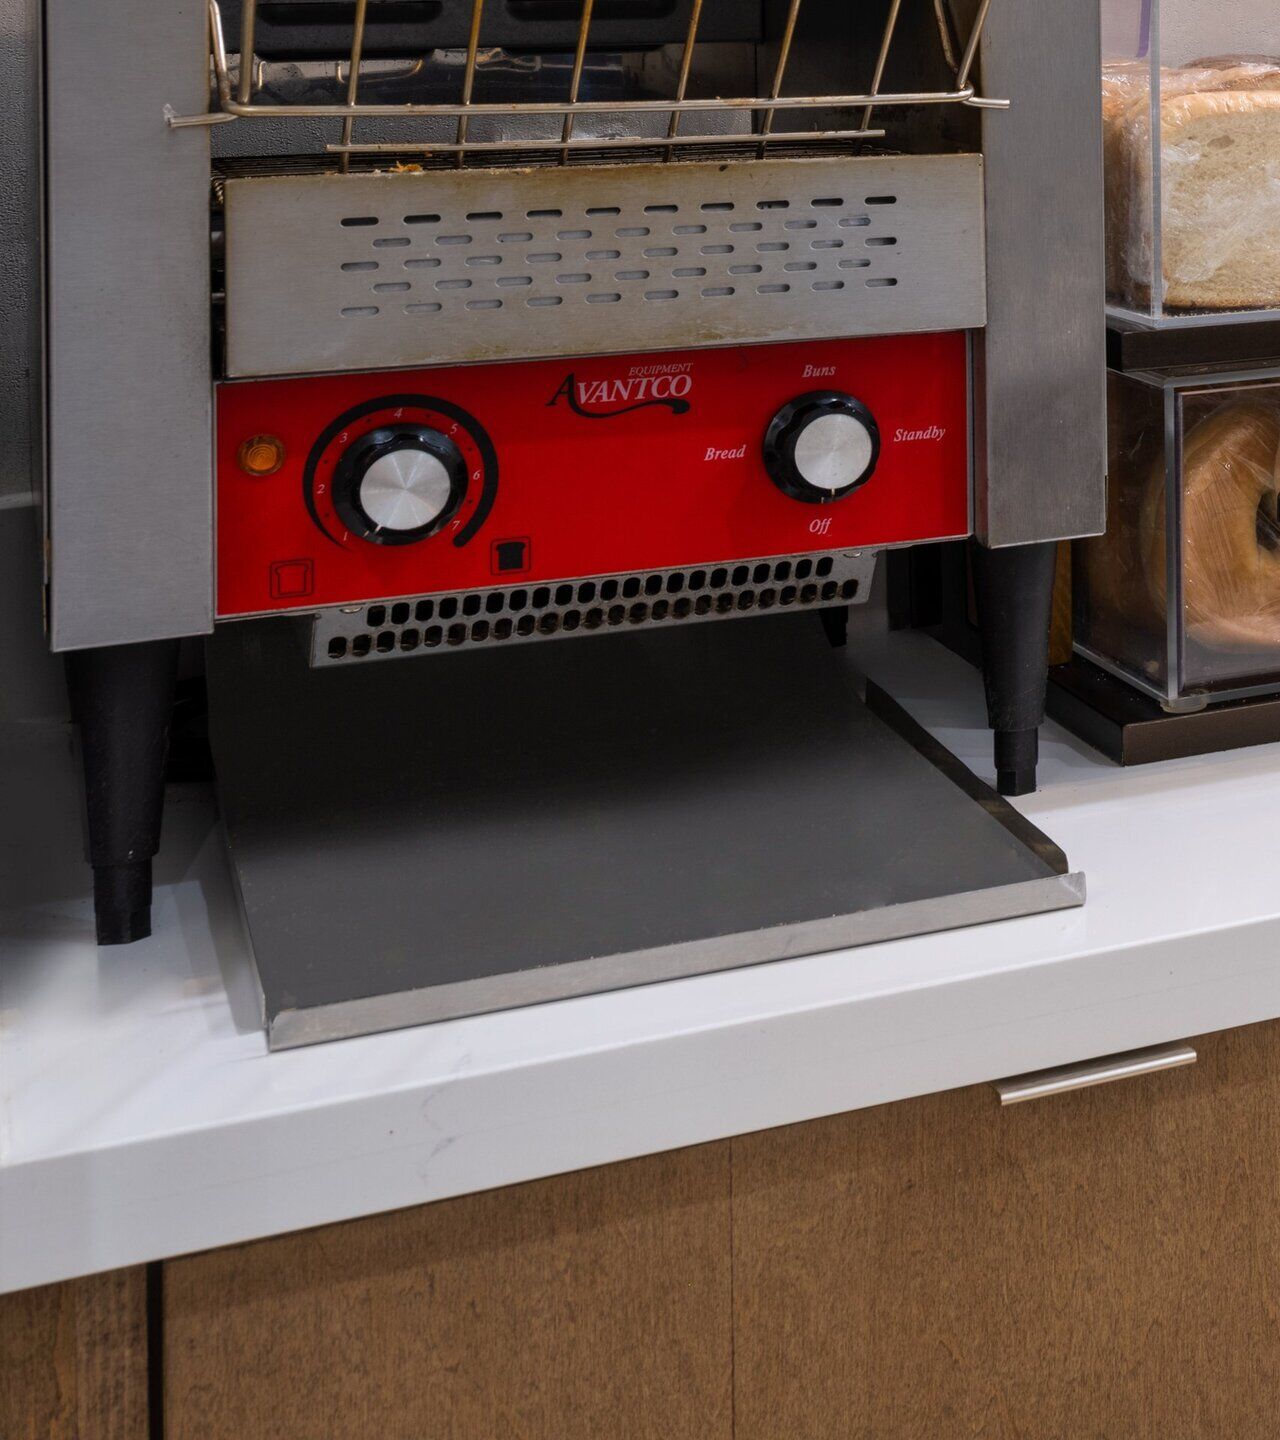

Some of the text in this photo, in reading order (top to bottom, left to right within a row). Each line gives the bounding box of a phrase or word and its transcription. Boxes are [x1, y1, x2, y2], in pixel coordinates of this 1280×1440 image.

[629, 363, 693, 376] EQUIPMENT
[802, 365, 836, 378] Buns
[545, 372, 692, 418] AVANTCO
[394, 408, 403, 418] 4
[450, 423, 458, 434] 5
[339, 432, 348, 443] 3
[893, 427, 946, 443] Standby
[704, 445, 747, 461] Bread
[473, 470, 481, 480] 6
[317, 483, 326, 494] 2
[452, 520, 461, 530] 7
[809, 517, 833, 535] Off
